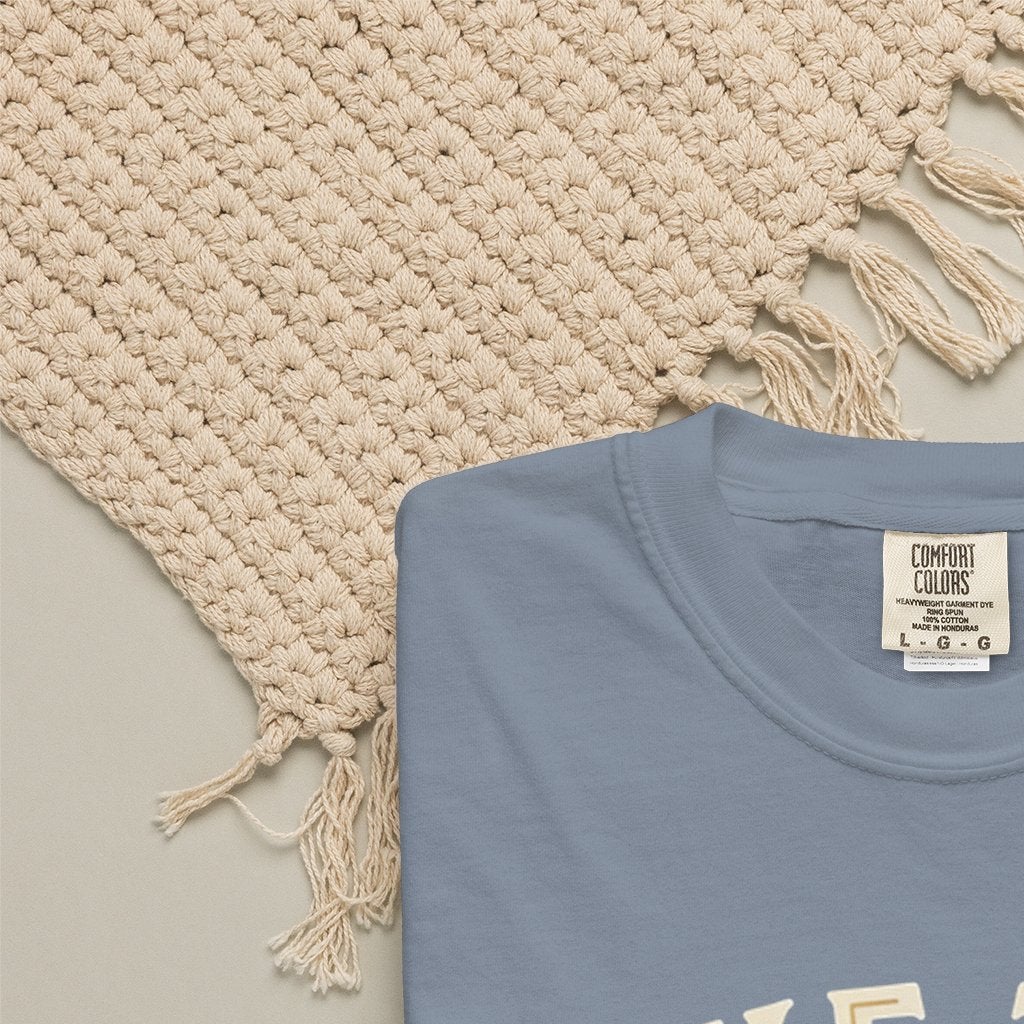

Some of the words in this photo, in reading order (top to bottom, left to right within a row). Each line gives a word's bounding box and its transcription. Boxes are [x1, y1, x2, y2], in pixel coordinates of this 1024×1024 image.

[911, 543, 976, 569] COMFORT
[895, 598, 944, 608] HEAVYWEIGHT
[945, 600, 979, 608] GARMENT
[979, 601, 994, 609] DYE
[926, 608, 944, 616] RING
[922, 616, 940, 624] 100%
[940, 616, 969, 624] COTTON
[912, 623, 932, 631] MADE
[900, 632, 911, 647] L
[936, 635, 950, 650] G
[977, 635, 991, 650] G
